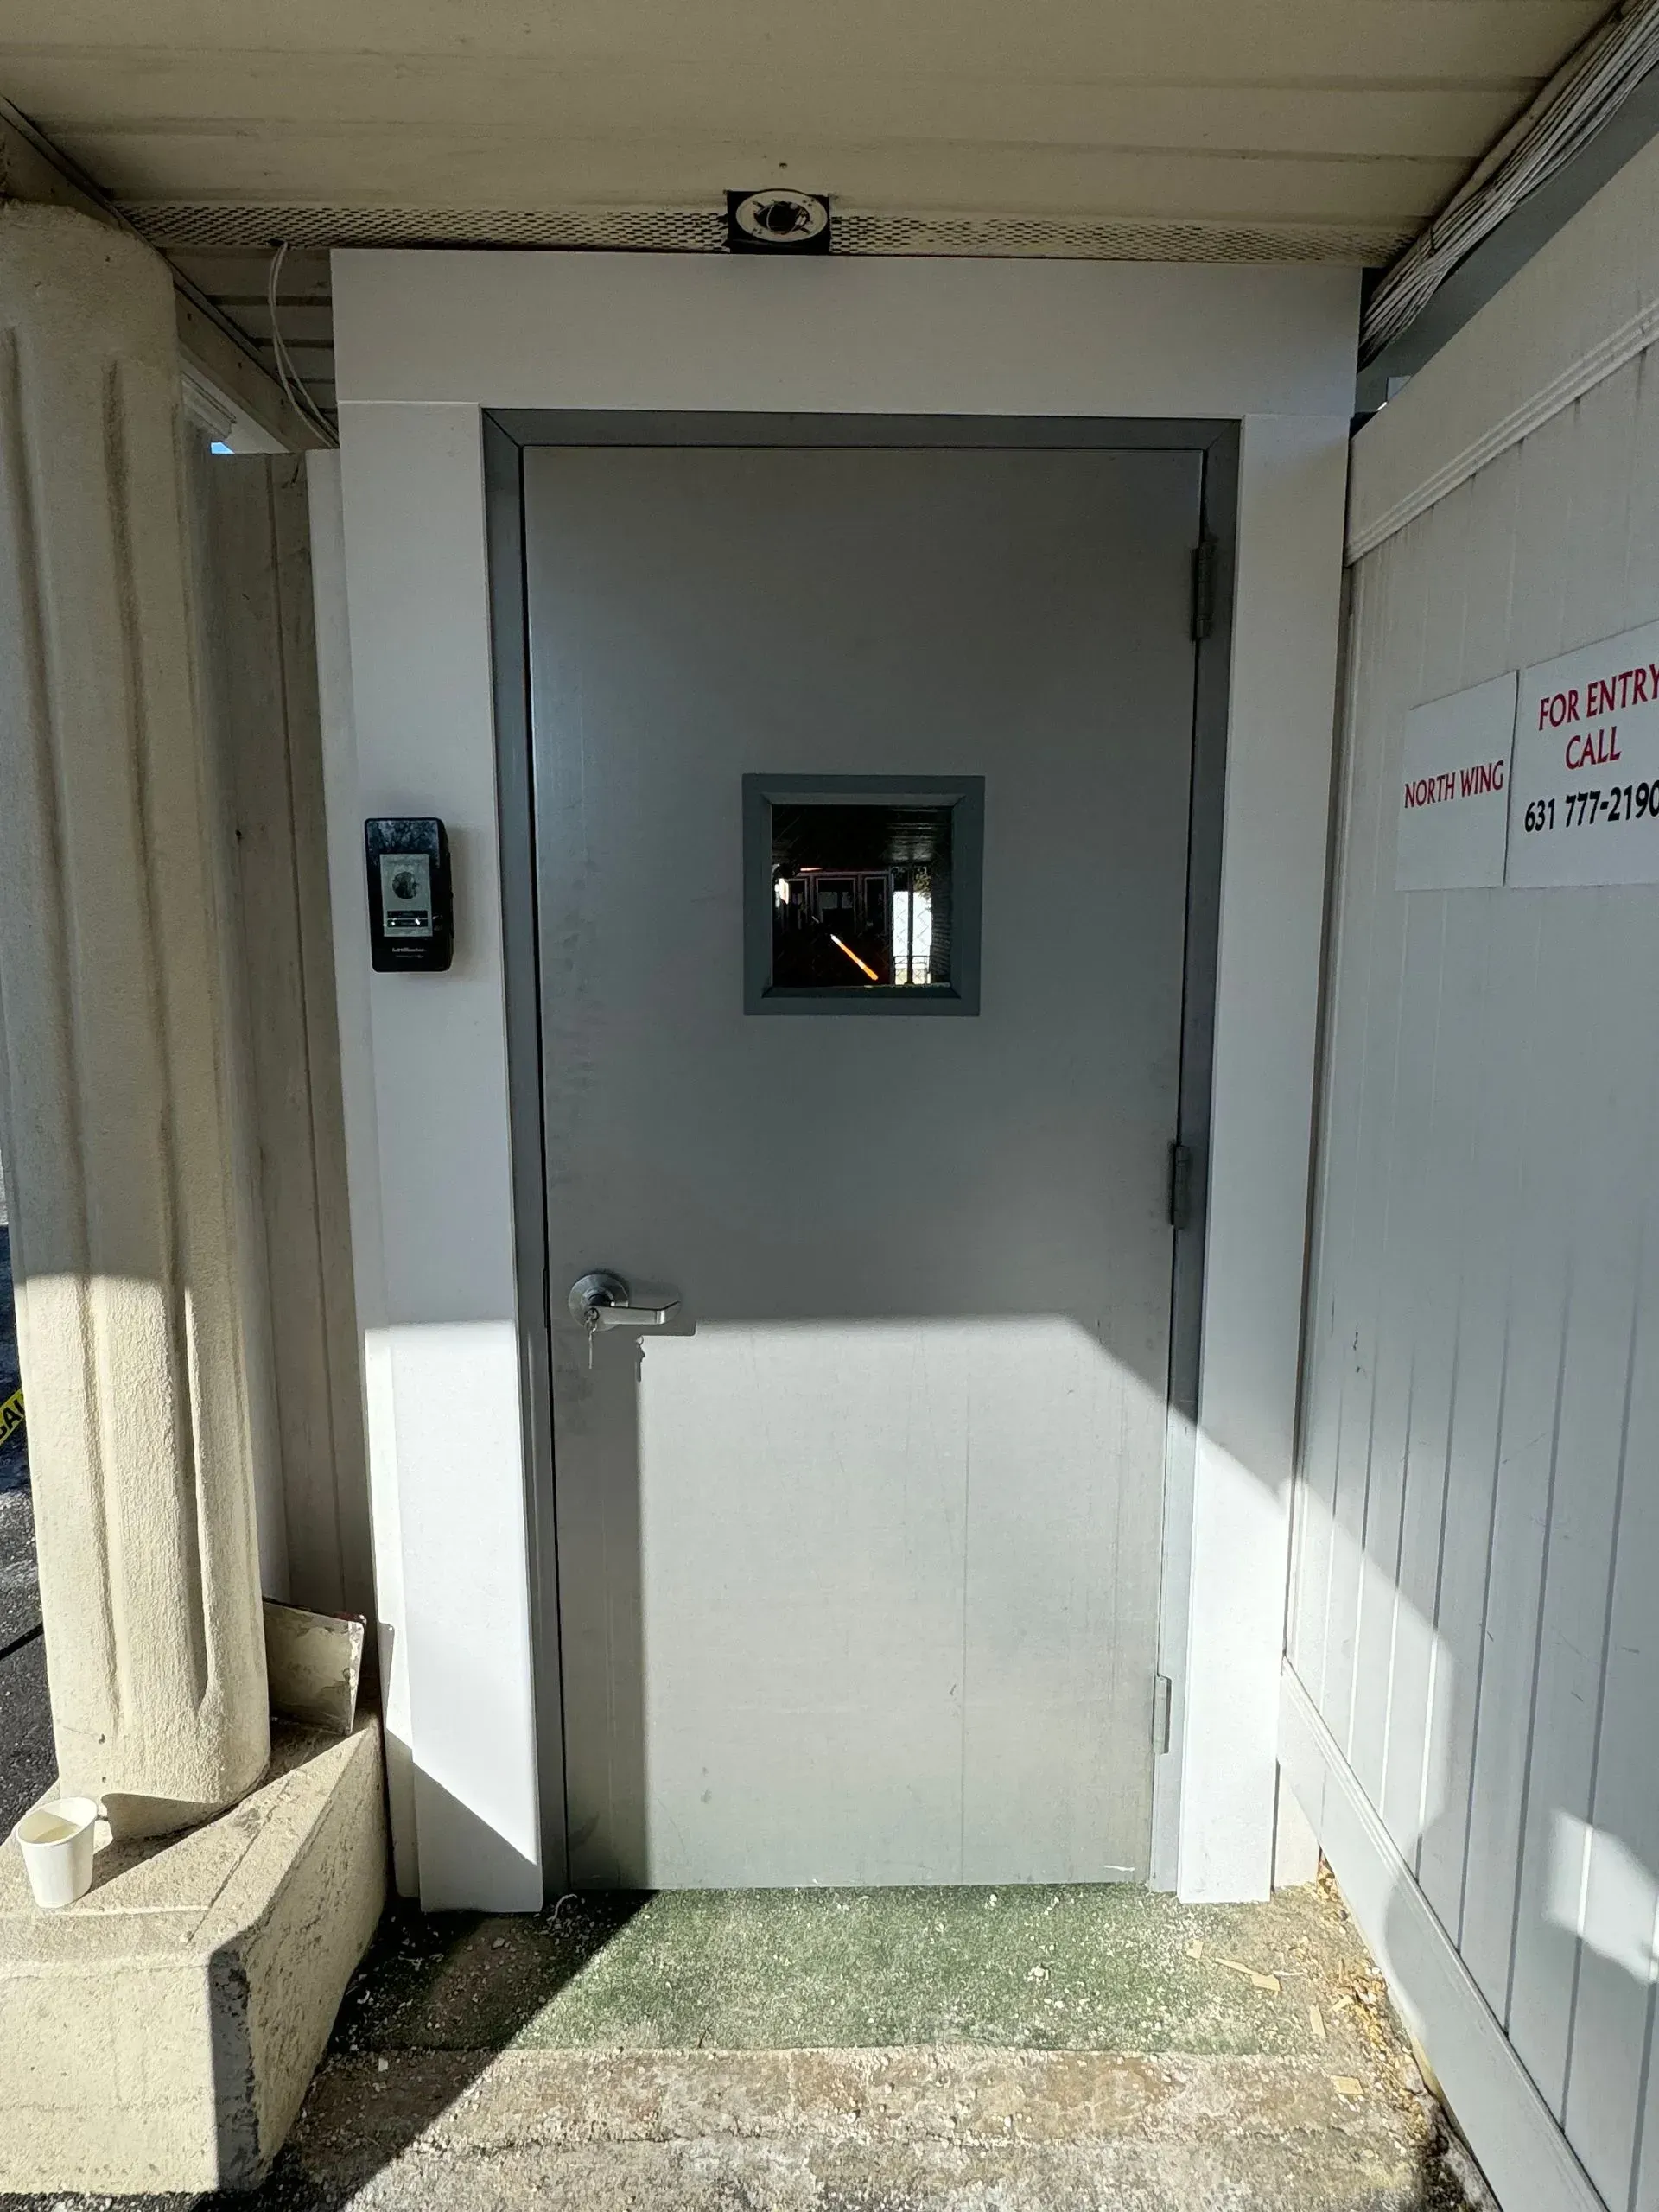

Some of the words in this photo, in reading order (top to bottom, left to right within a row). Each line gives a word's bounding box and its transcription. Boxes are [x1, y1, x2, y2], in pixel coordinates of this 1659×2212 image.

[1538, 689, 1580, 731] FOR
[1586, 663, 1659, 718] ENTRY
[1565, 726, 1621, 771] CALL
[1404, 772, 1455, 808] NORTH
[1459, 760, 1504, 798] WING
[1524, 798, 1555, 834] 631
[1565, 779, 1659, 829] 777-2190
